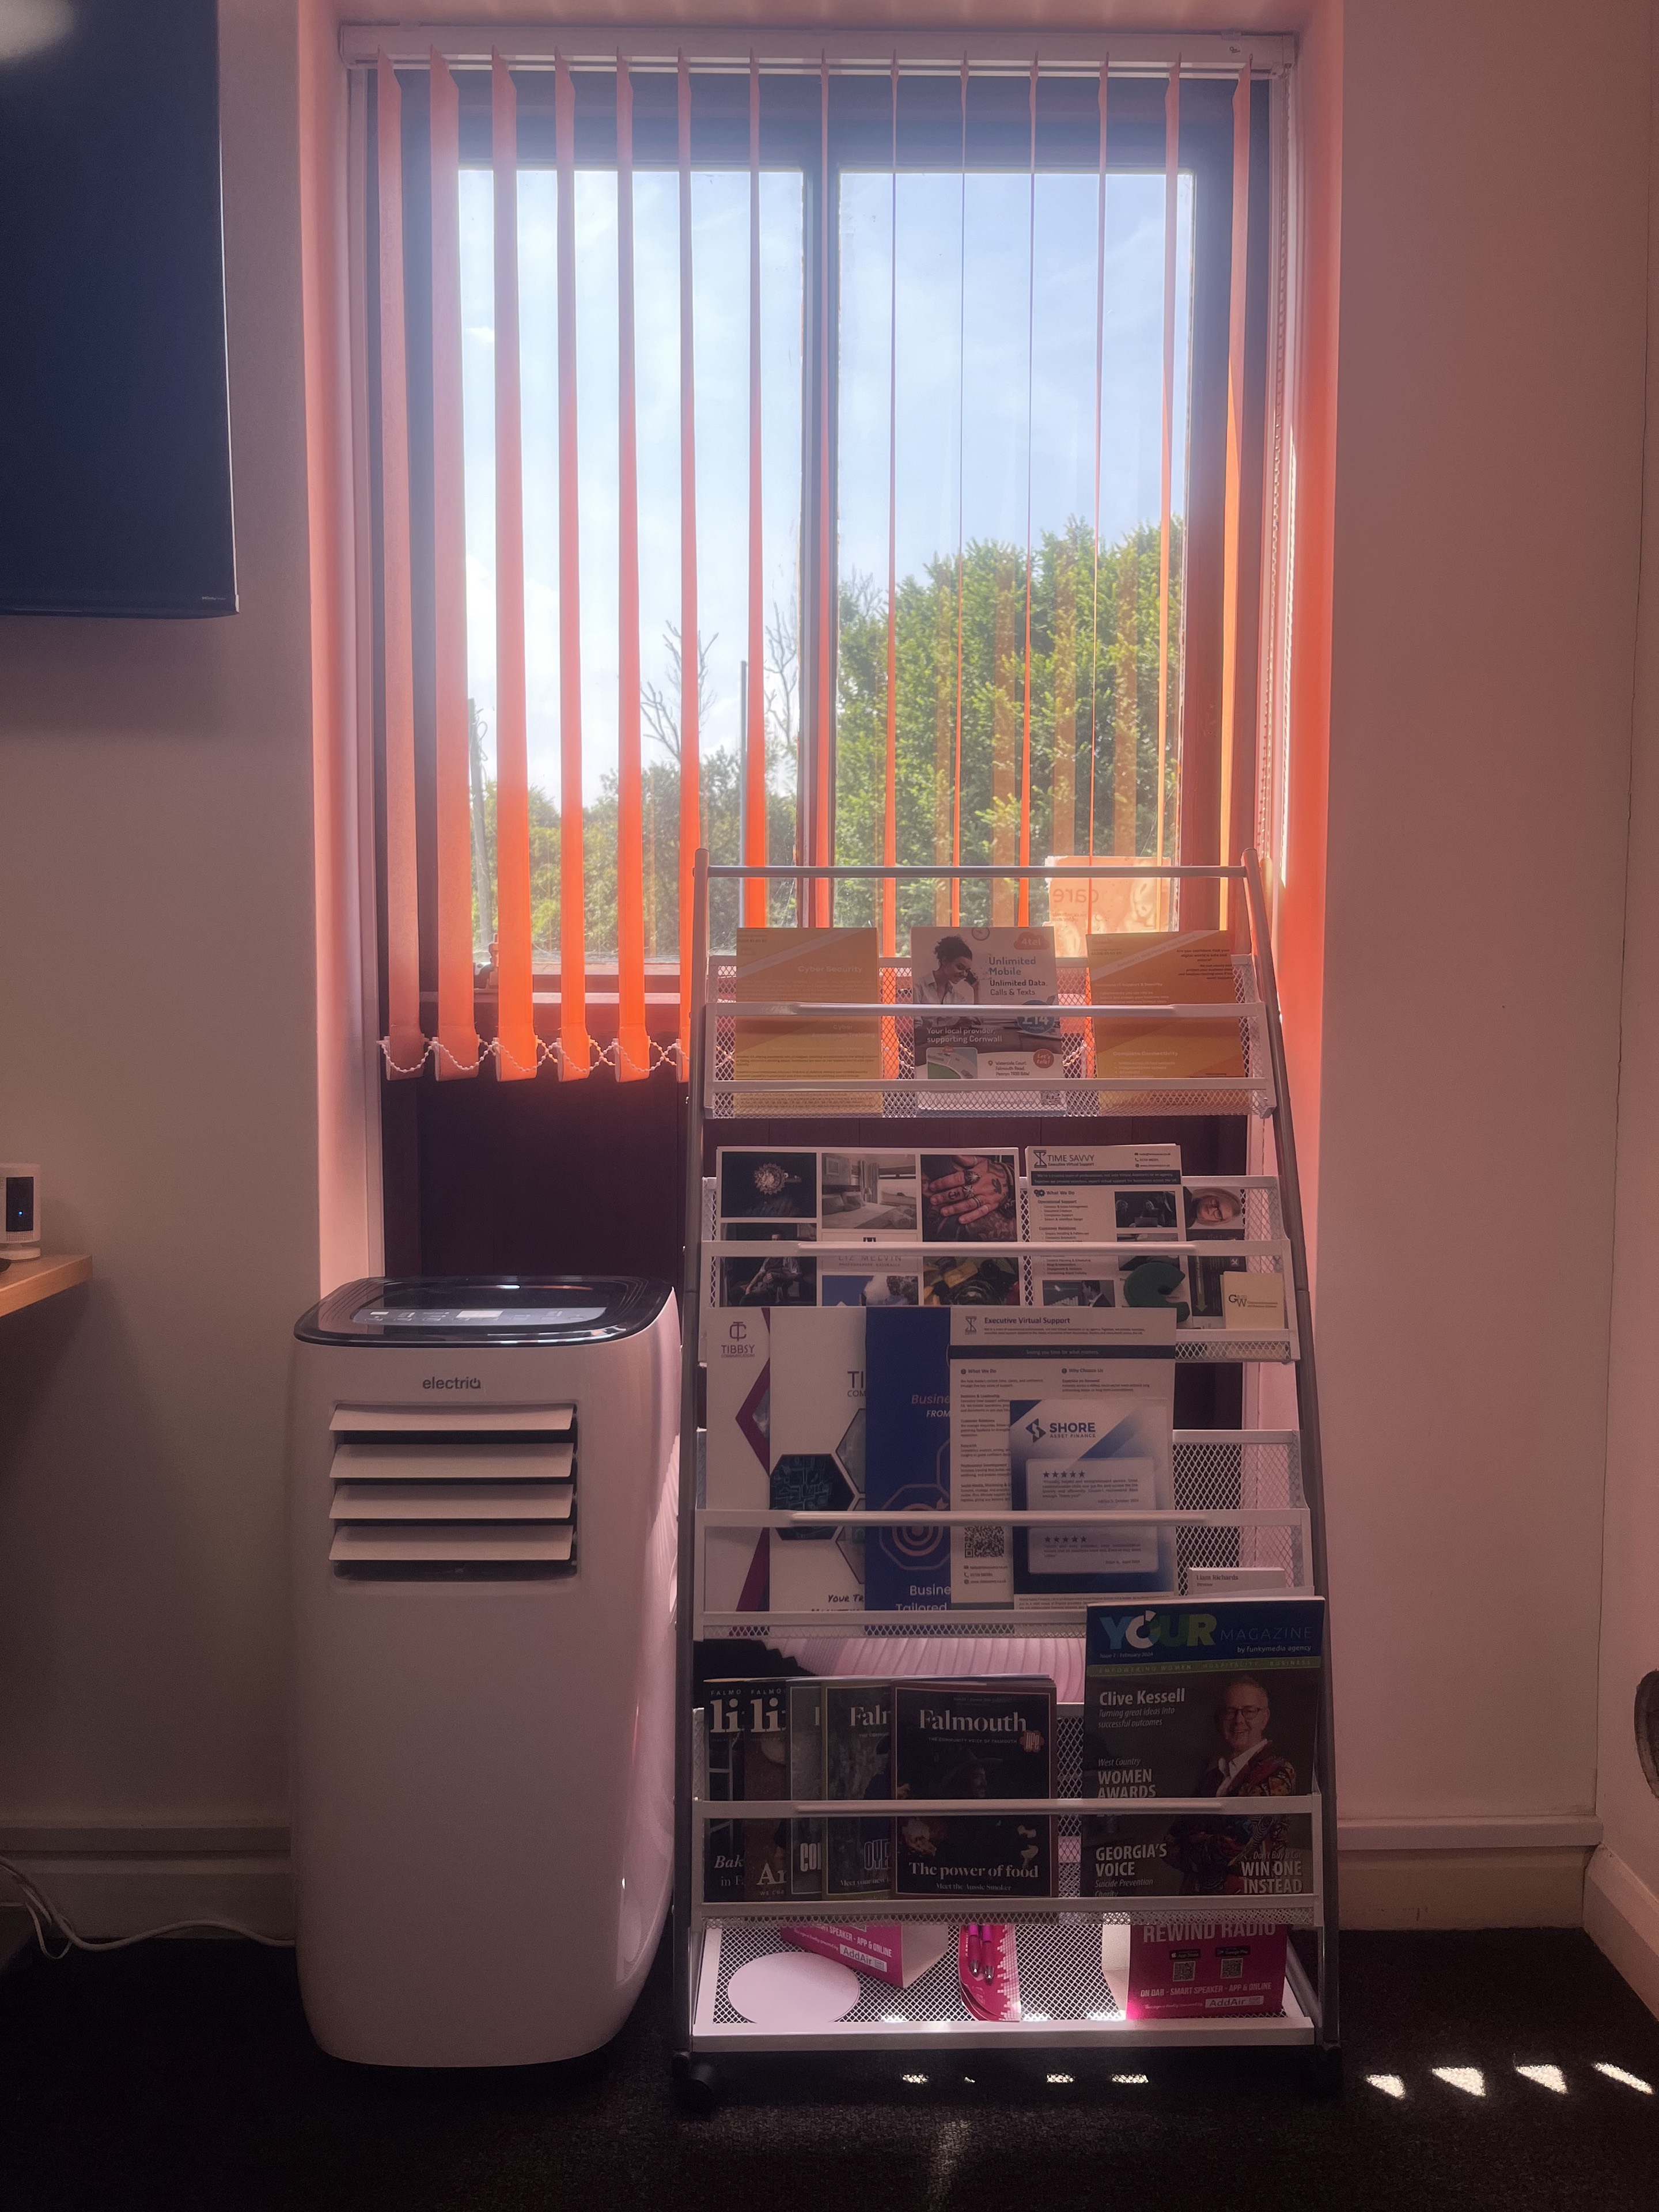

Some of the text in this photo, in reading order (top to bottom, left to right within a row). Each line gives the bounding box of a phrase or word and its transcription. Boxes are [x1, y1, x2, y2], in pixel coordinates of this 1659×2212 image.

[1021, 936, 1041, 946] 4tel
[988, 956, 1036, 965] Unlimited
[798, 965, 863, 974] Cyber Security
[989, 967, 1021, 975] Mobile
[964, 1027, 996, 1036] provider,
[926, 1036, 968, 1044] supporting
[1070, 1154, 1094, 1162] SAVVY
[1043, 1317, 1070, 1325] Support
[721, 1344, 755, 1354] TIBBSY
[926, 1410, 950, 1418] FROM
[1049, 1422, 1096, 1433] SHORE
[828, 1594, 850, 1603] YOUR
[896, 1603, 948, 1611] Tailored
[1099, 1609, 1312, 1650] YOUR MAGAZINE
[1246, 1645, 1286, 1653] funkymedia
[1287, 1645, 1312, 1653] agency
[1099, 1665, 1156, 1674] EMPOWERING
[1099, 1688, 1185, 1706] Clive Kessell
[710, 1698, 745, 1733] li
[750, 1698, 786, 1733] li
[1099, 1707, 1175, 1719] Turning great ideas into
[920, 1709, 1027, 1732] Falmouth
[1098, 1718, 1162, 1729] successful outcomes
[1098, 1758, 1141, 1767] West Country
[1097, 1768, 1152, 1785] WOMEN
[1097, 1784, 1157, 1798] AWARDS
[1096, 1843, 1167, 1861] GEORGIA'S
[1271, 1850, 1285, 1860] Buy
[714, 1854, 744, 1869] Bak
[909, 1862, 1039, 1880] The power of food
[1095, 1862, 1135, 1877] VOICE
[1240, 1860, 1302, 1876] WIN ONE
[721, 1874, 744, 1887] in F
[857, 1878, 871, 1887] your
[1095, 1877, 1154, 1888] Suicide Prevention
[1244, 1878, 1302, 1894] INSTEAD
[1095, 1889, 1119, 1897] Charity
[1143, 1923, 1277, 1943] REWIND RADIO
[830, 1925, 893, 1958] SPEAKER APP & ONLINE
[843, 1946, 873, 1966] AddAir
[1140, 1990, 1150, 1998] ON
[1151, 1988, 1165, 1997] DAB
[1170, 1986, 1194, 1996] SMART
[1194, 1985, 1224, 1995] SPEAKER
[1228, 1984, 1241, 1993] APP
[1248, 1982, 1272, 1991] ONLINE
[1210, 1998, 1247, 2008] AddAir
